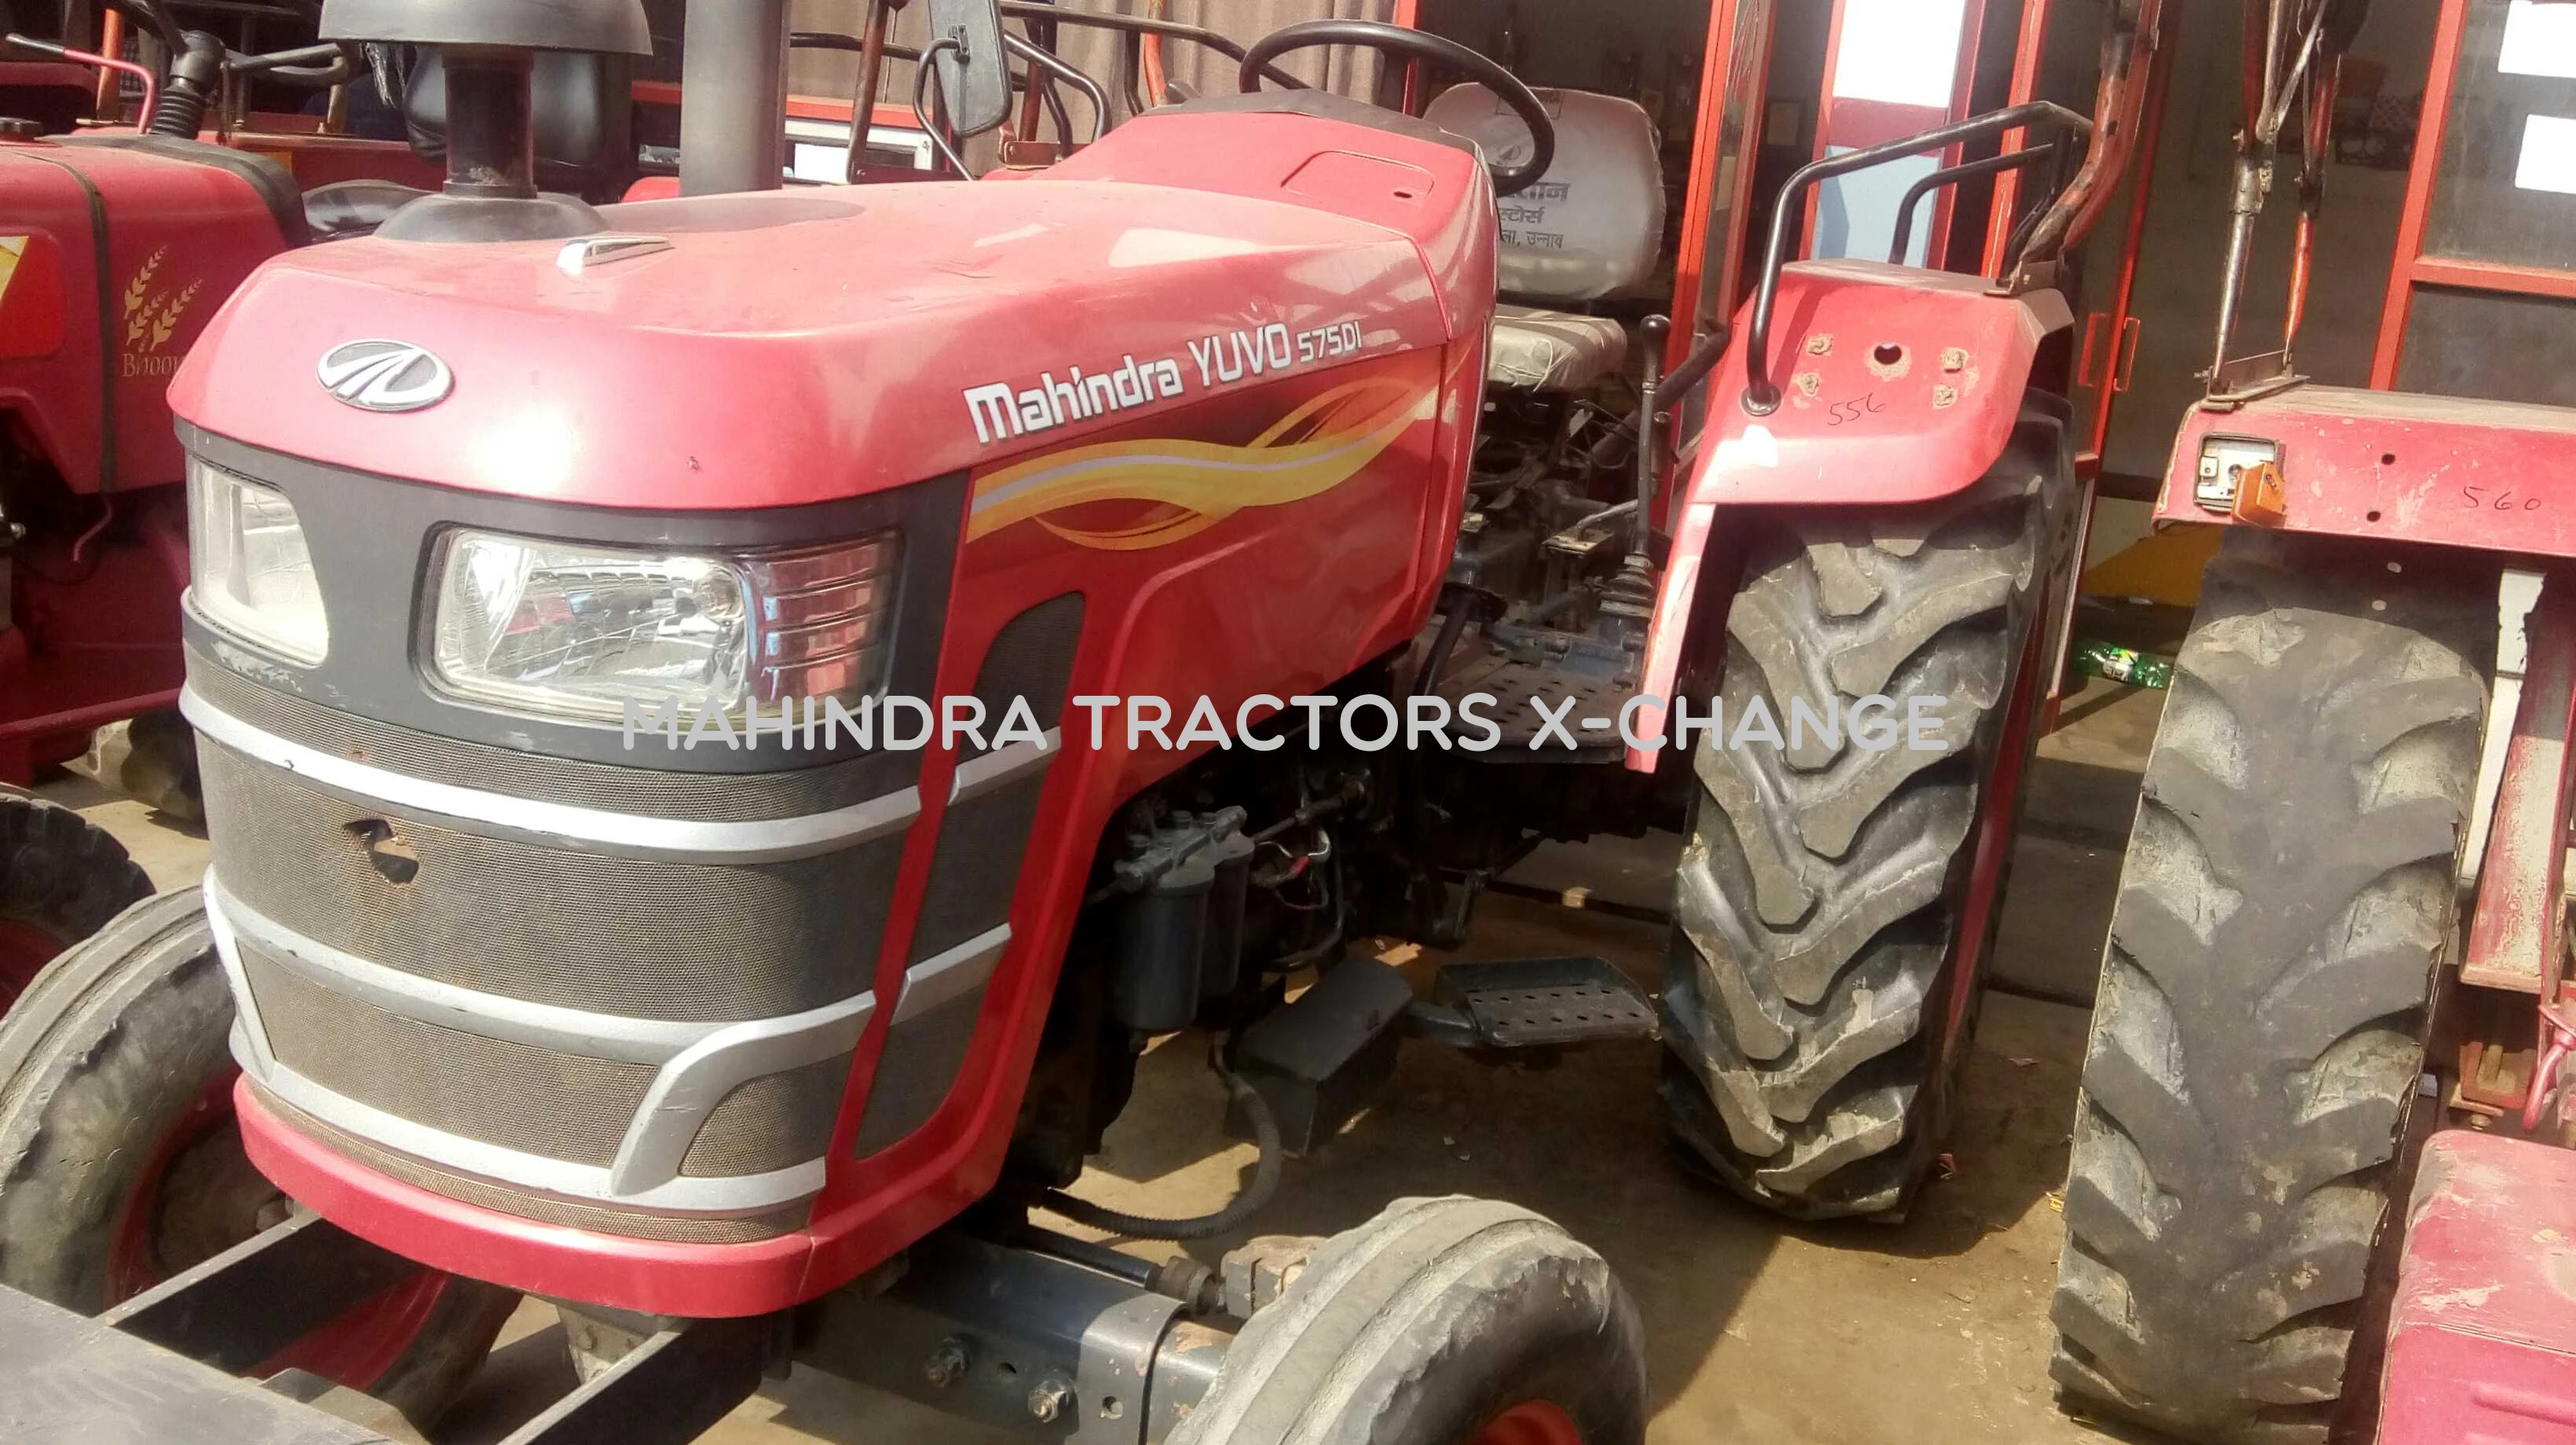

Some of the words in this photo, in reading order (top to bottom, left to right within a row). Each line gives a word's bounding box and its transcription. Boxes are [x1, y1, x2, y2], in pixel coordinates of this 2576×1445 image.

[963, 353, 1184, 445] Mahindra
[1187, 322, 1292, 387] YUVO
[1297, 320, 1363, 364] 575DI
[1827, 393, 1886, 426] 556
[2463, 485, 2542, 510] 560
